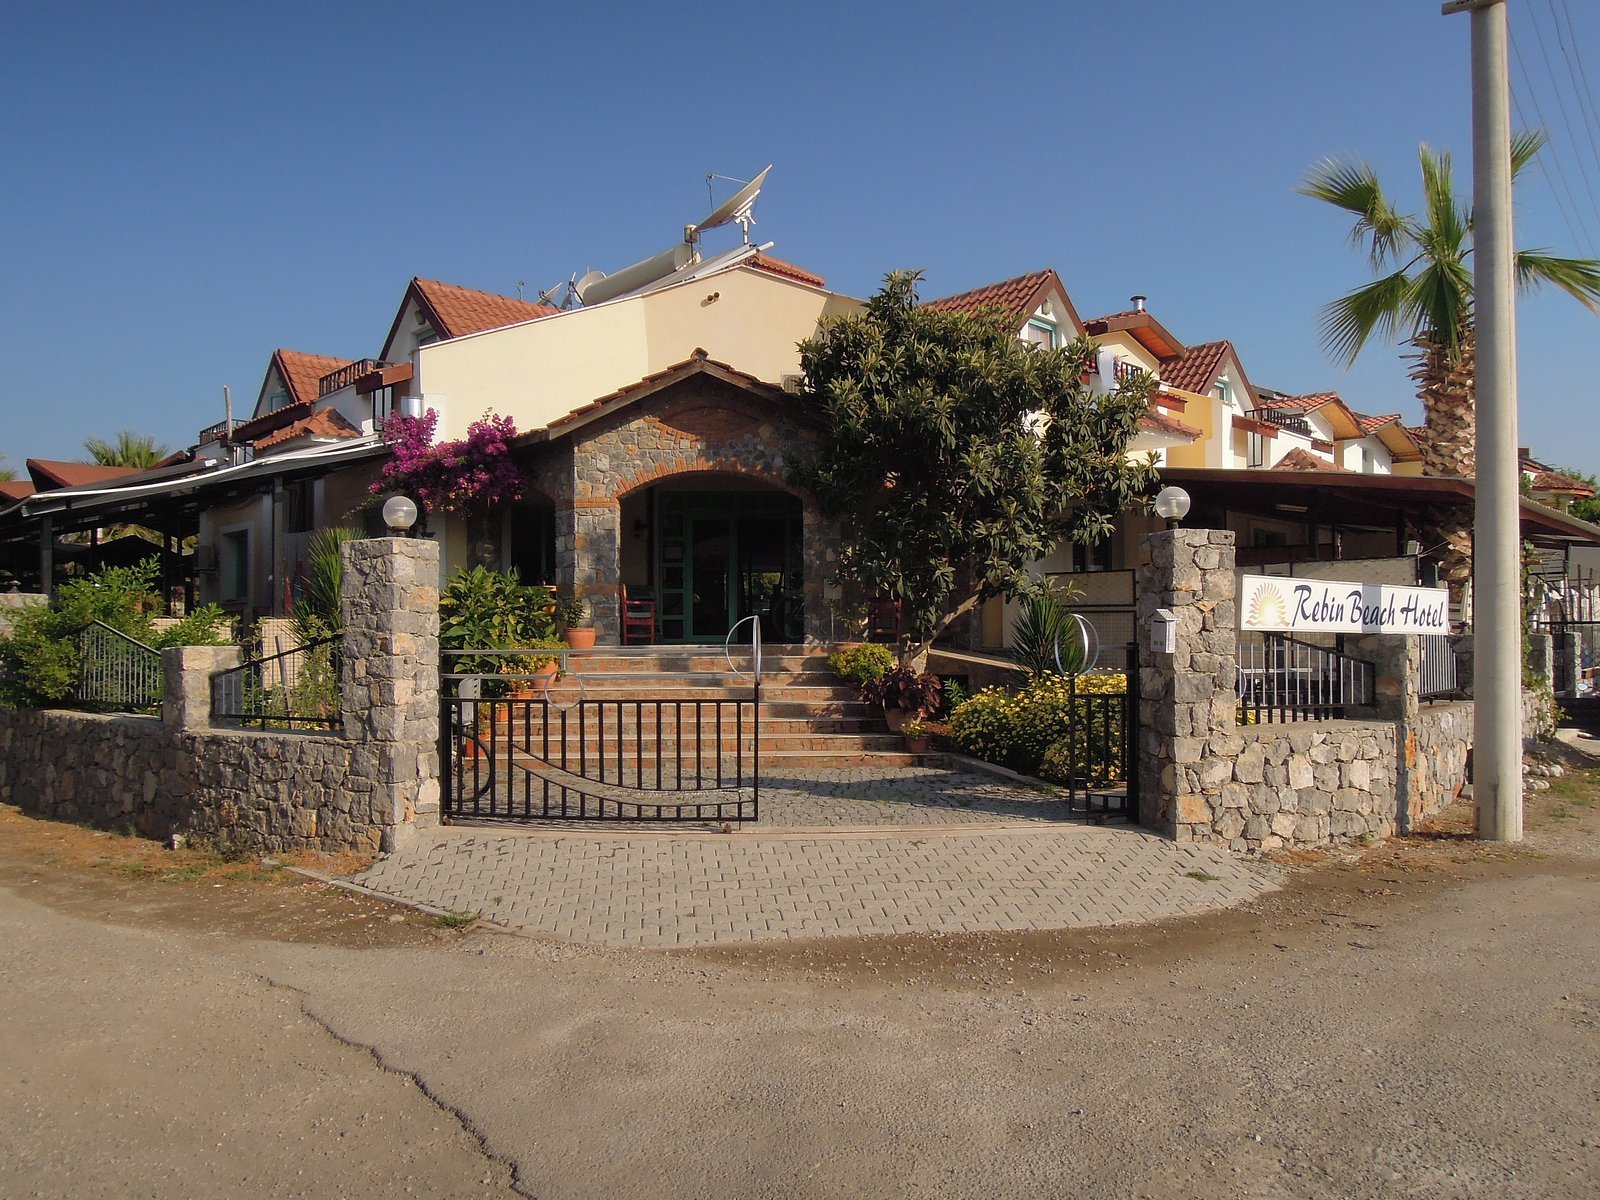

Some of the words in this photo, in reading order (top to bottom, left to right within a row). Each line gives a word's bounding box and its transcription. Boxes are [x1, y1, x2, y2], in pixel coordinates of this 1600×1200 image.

[1292, 585, 1344, 627] Rebin
[1346, 590, 1395, 626] Beach
[1400, 594, 1444, 627] Hotel
